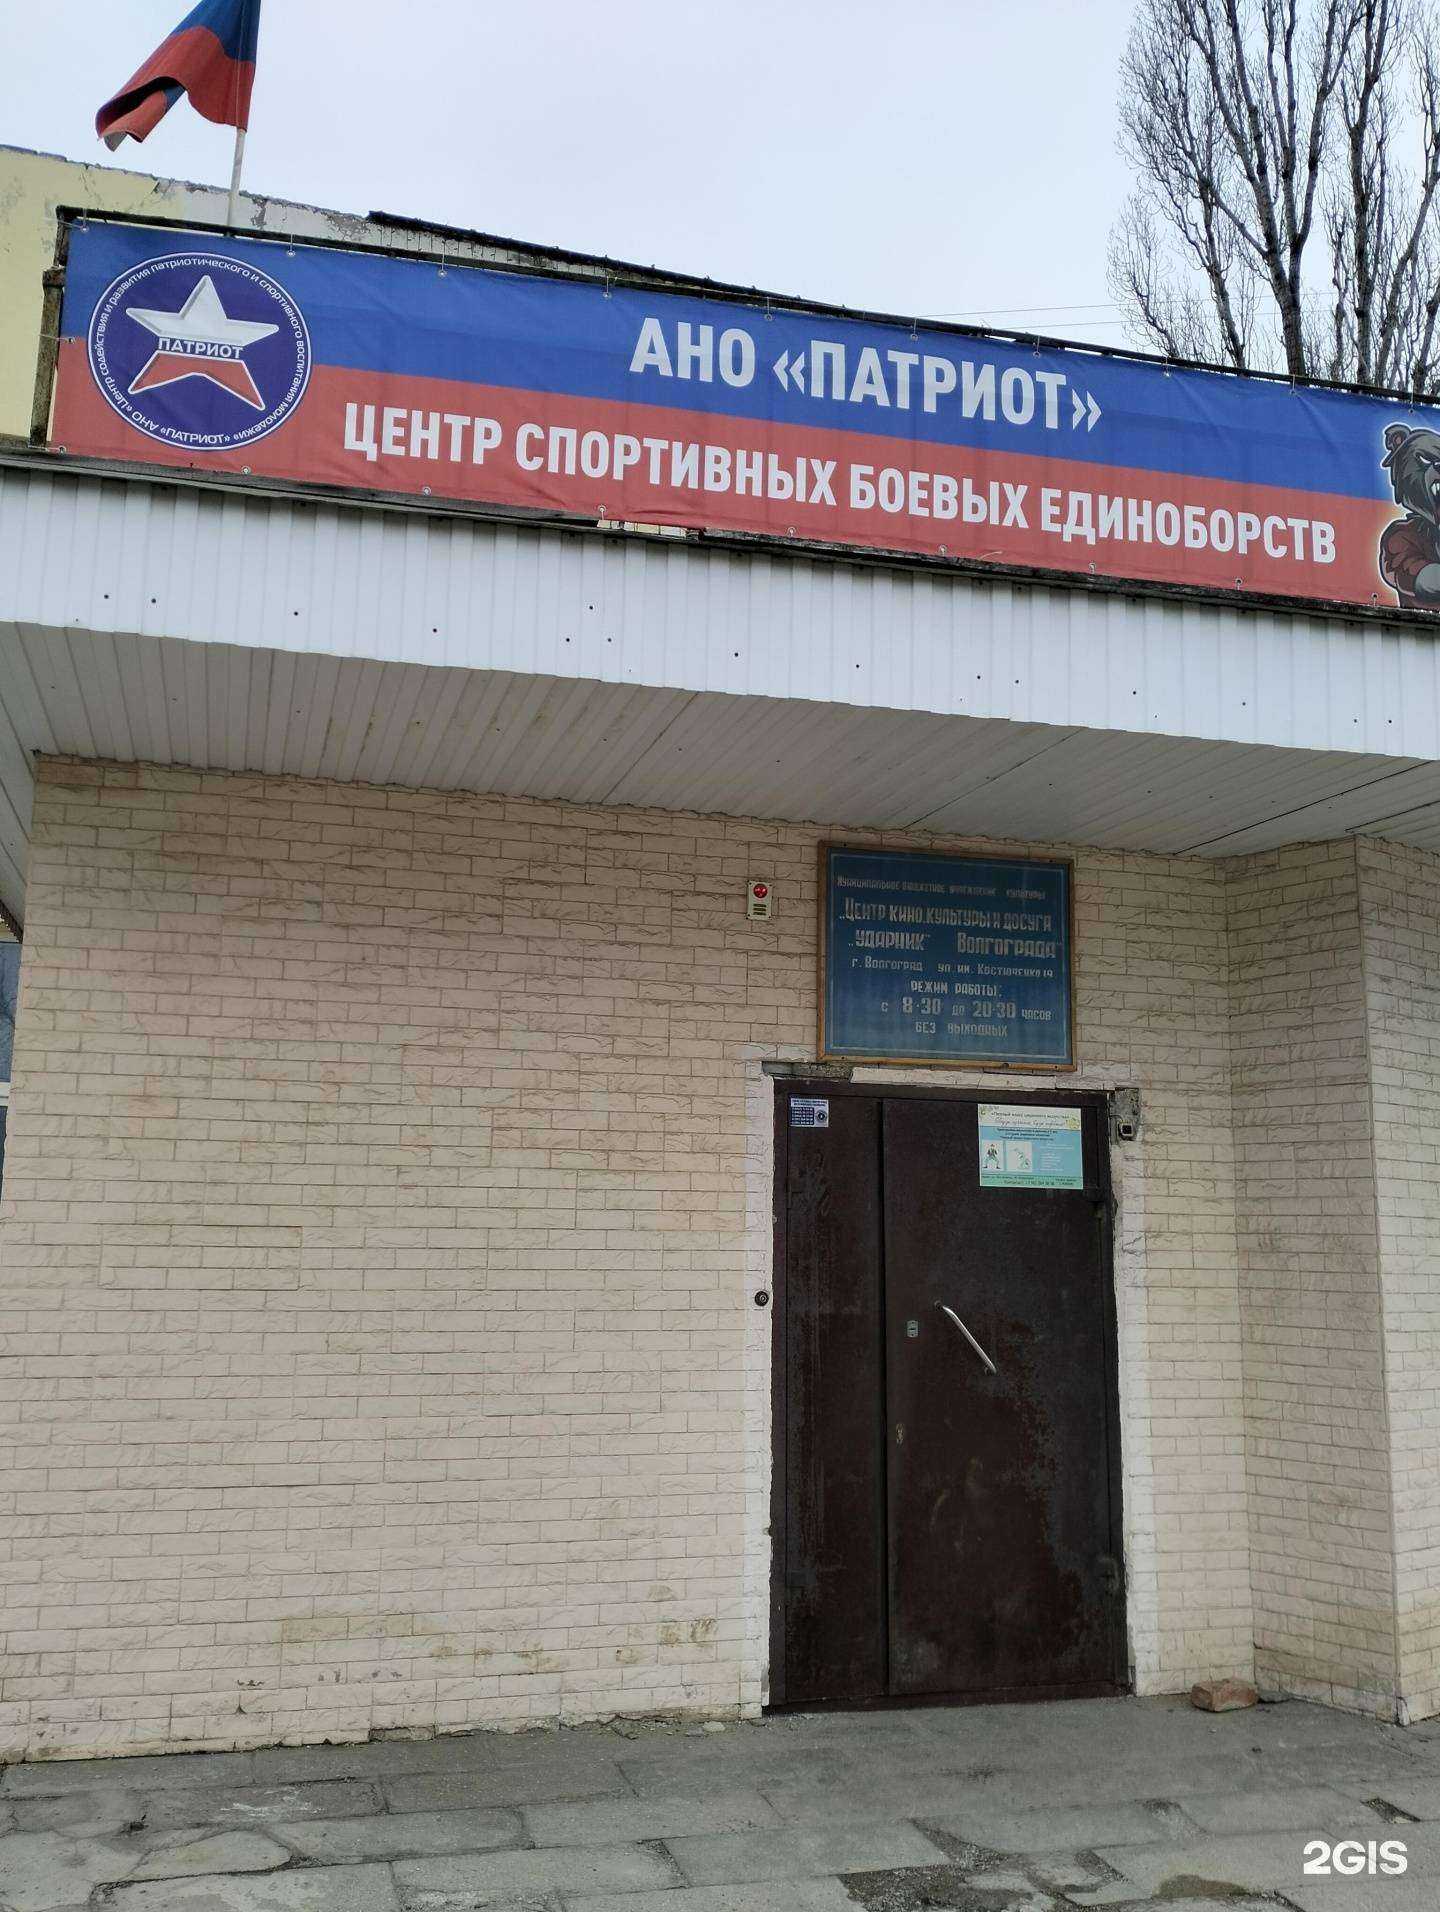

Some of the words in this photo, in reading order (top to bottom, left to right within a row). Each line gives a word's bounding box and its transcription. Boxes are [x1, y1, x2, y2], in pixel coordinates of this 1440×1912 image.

[151, 257, 251, 278] патриотического
[109, 268, 151, 307] развития
[258, 278, 304, 339] спортивного
[157, 337, 244, 360] ПАТРИОТ
[284, 339, 305, 403] воспитания
[629, 317, 756, 388] АНО
[772, 338, 1103, 433] «ПАТРИОТ»
[131, 410, 160, 431] АНО
[160, 427, 231, 445] «ПАТРИОТ»
[343, 402, 503, 465] ЦЕНТР
[515, 422, 839, 507] СПОРТИВНЫХ
[849, 463, 1030, 530] БОЕВЫХ
[1041, 486, 1338, 565] ЕДИНОБОРСТВ
[910, 980, 948, 995] РЕЖИМ
[915, 1021, 936, 1035] БЕЗ
